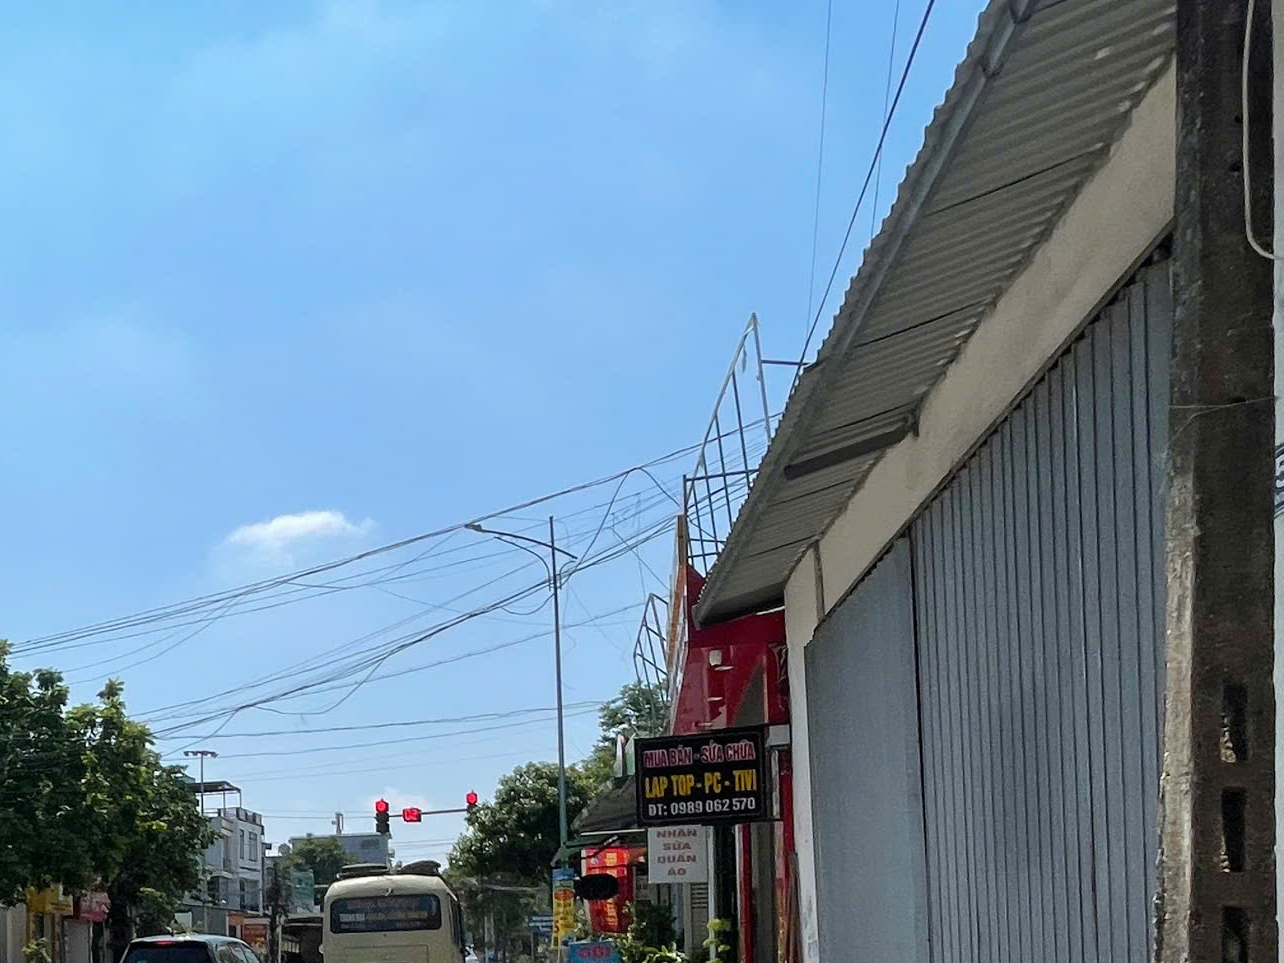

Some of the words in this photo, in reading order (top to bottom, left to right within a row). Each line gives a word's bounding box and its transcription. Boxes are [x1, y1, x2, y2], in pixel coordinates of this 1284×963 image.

[643, 749, 668, 768] MUA
[645, 776, 668, 799] LAP
[670, 774, 695, 797] TOP
[704, 771, 722, 794] PC
[732, 769, 756, 792] TIVI
[670, 800, 703, 815] 0989
[705, 798, 730, 813] 062
[732, 796, 756, 811] 570
